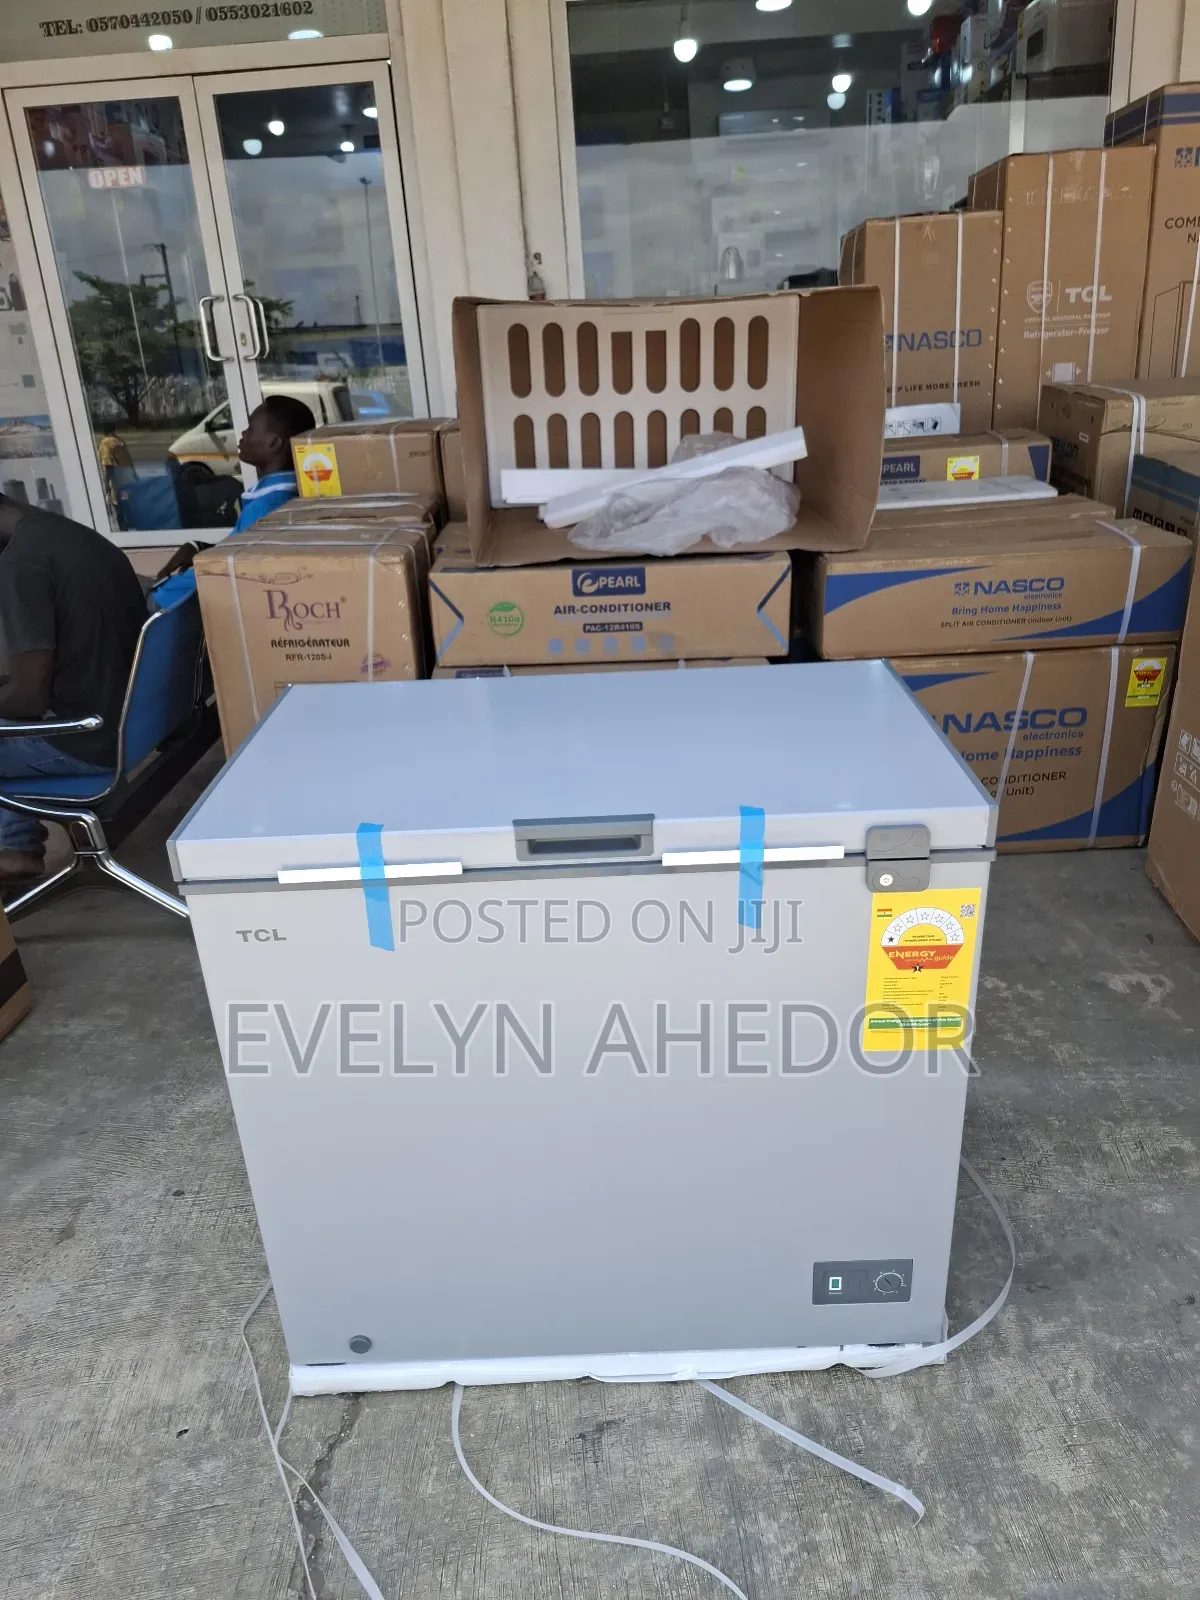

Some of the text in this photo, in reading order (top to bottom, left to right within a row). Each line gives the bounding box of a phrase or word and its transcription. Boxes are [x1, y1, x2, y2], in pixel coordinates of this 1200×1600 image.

[39, 18, 83, 37] TEL:
[86, 9, 193, 33] 0570442050
[205, 0, 313, 23] 0553021602
[89, 167, 144, 187] OPEN
[1065, 285, 1112, 304] TCL
[1023, 327, 1110, 340] Refrgerator-Frezer
[897, 329, 982, 352] NASCO
[904, 384, 924, 392] LIFE
[925, 382, 950, 391] MORE
[952, 380, 981, 389] RESH
[883, 462, 916, 473] PEARL
[599, 576, 641, 589] PEARL
[974, 577, 1064, 595] NASCO
[1024, 592, 1063, 600] electronics
[554, 602, 671, 615] AIR-CONDITIONER
[952, 602, 1062, 616] Bring Home Happiness
[940, 621, 960, 629] SPLIT
[976, 618, 1026, 626] CONDITIONER
[271, 637, 350, 648] RÉFRIGÉRATEUR
[942, 707, 1088, 735] NASCO
[1023, 730, 1085, 741] electronics
[981, 771, 1067, 786] CODITIONER
[1006, 786, 1035, 796] Unit)
[235, 928, 287, 942] TCL
[889, 950, 936, 959] ENERGY
